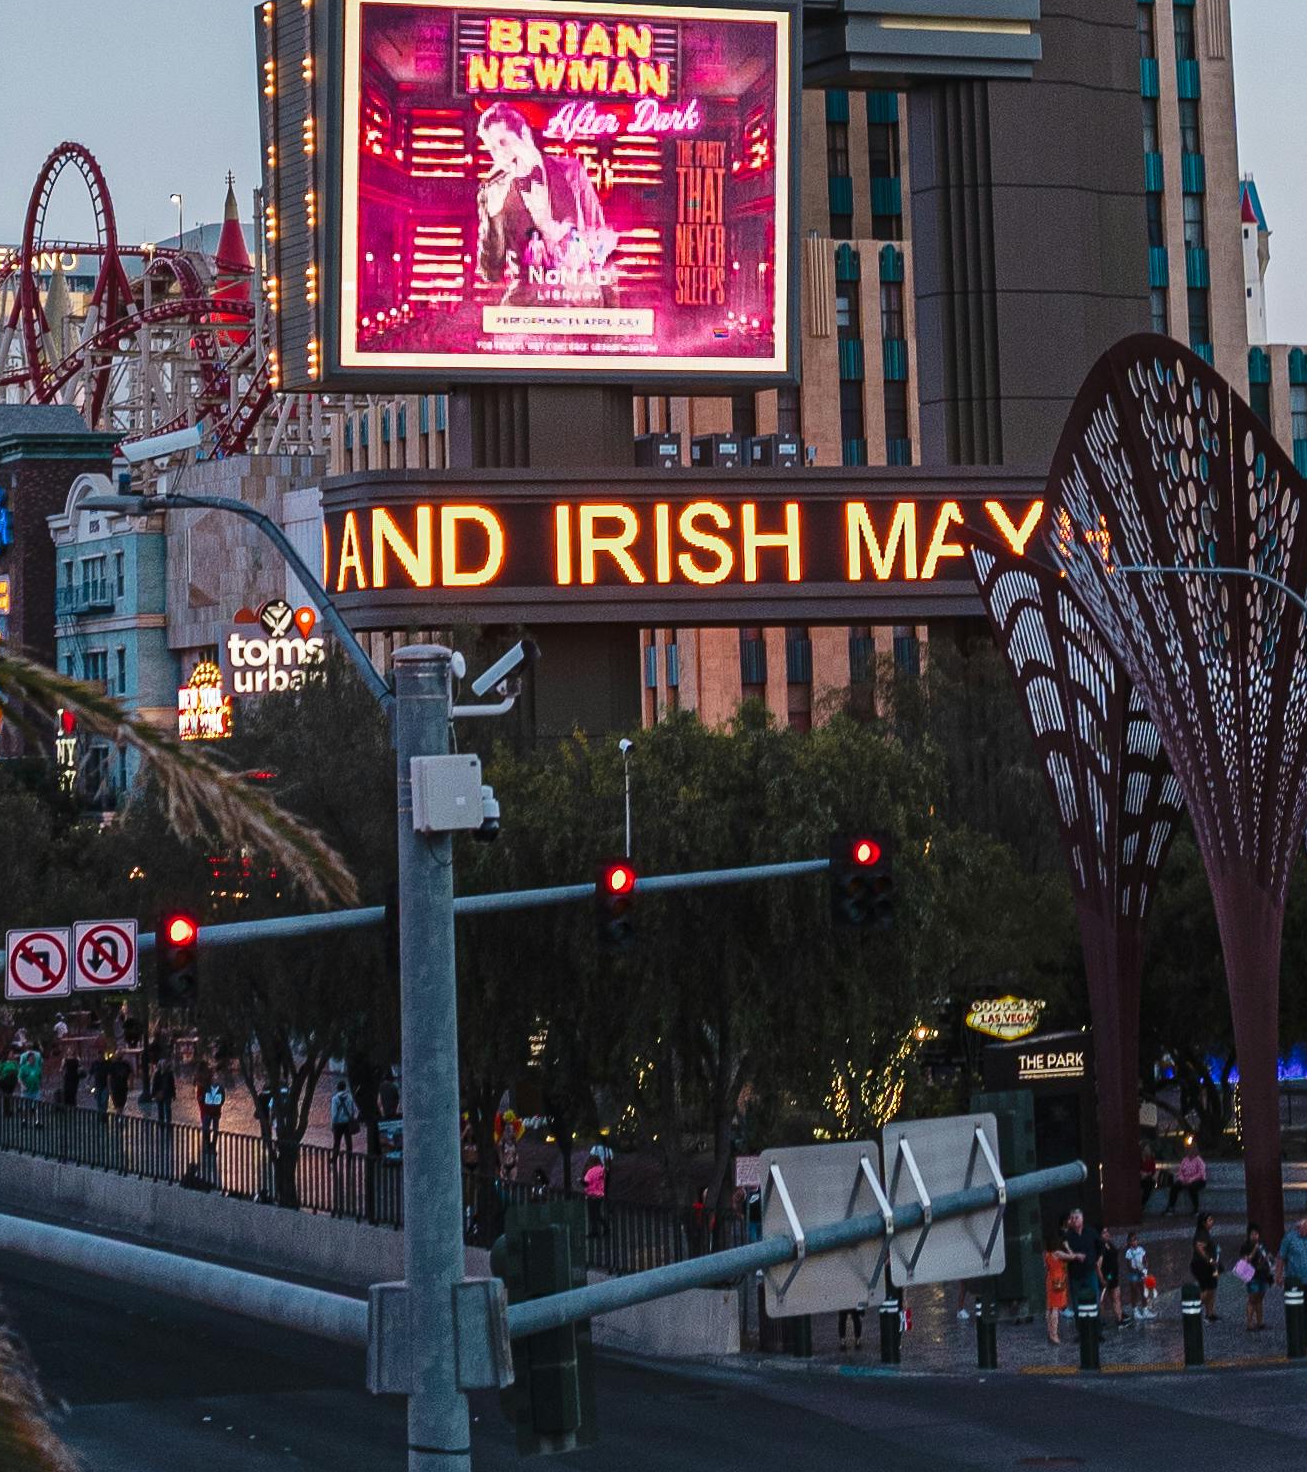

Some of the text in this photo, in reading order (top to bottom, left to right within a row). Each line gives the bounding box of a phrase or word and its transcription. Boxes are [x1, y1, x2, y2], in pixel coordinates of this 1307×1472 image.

[488, 17, 653, 59] BRIAN
[467, 55, 670, 99] NEWMAN
[542, 99, 701, 144] After Dark
[676, 168, 726, 224] THAT
[675, 224, 726, 267] NEVER
[675, 267, 726, 305] SLEEPS
[337, 505, 503, 591] AND
[556, 501, 800, 585] IRISH
[227, 633, 325, 667] toms
[55, 738, 77, 766] NY
[981, 1013, 1001, 1023] LAS
[1019, 1051, 1085, 1069] THE PARK
